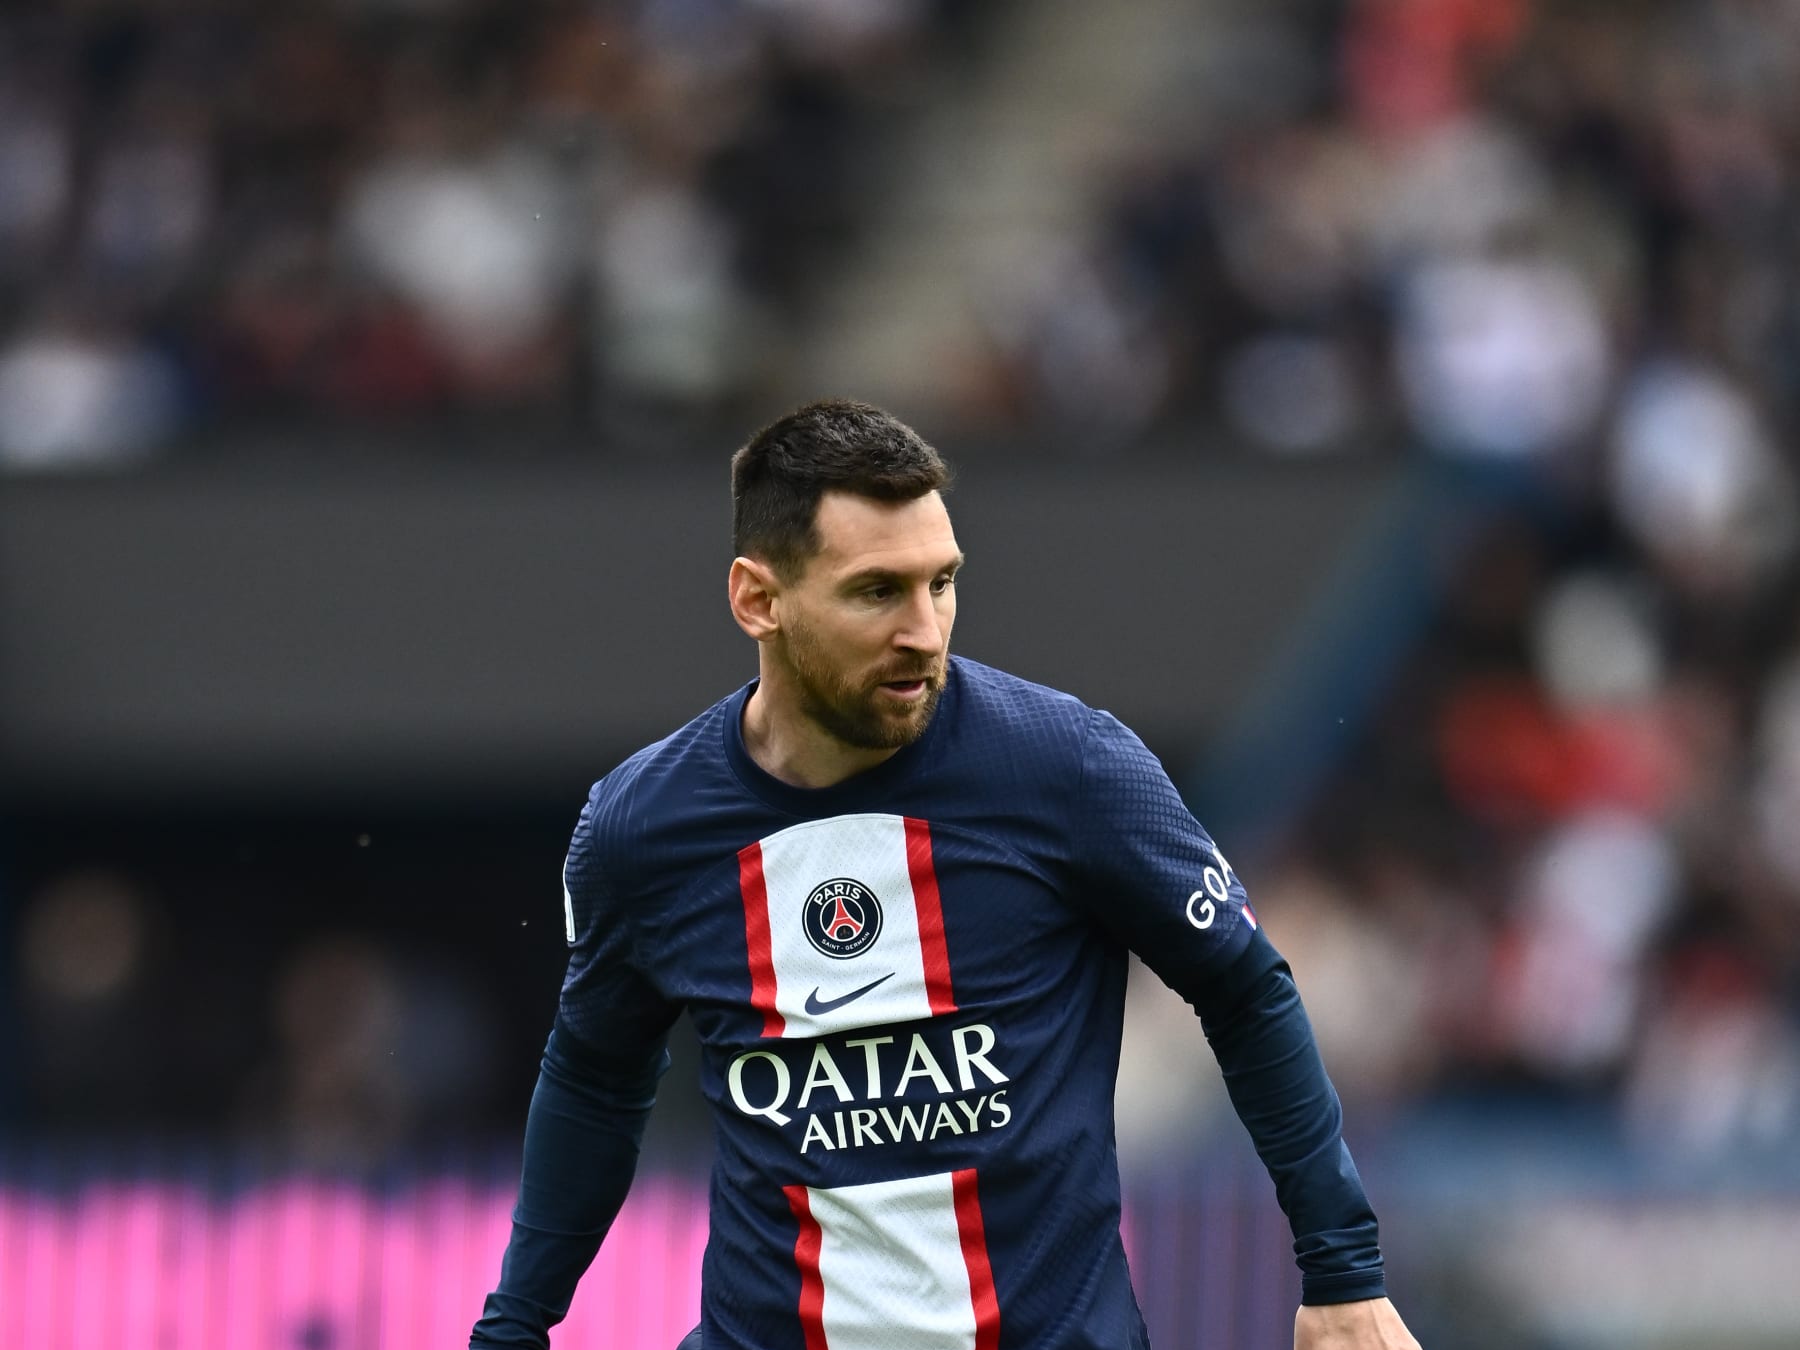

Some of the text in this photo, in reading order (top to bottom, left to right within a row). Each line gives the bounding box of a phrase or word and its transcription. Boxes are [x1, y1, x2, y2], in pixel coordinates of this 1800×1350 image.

[813, 883, 862, 906] PARIS
[1186, 840, 1233, 930] GOA
[728, 1024, 1010, 1127] QATAR
[800, 1090, 1012, 1154] AIRWAYS
